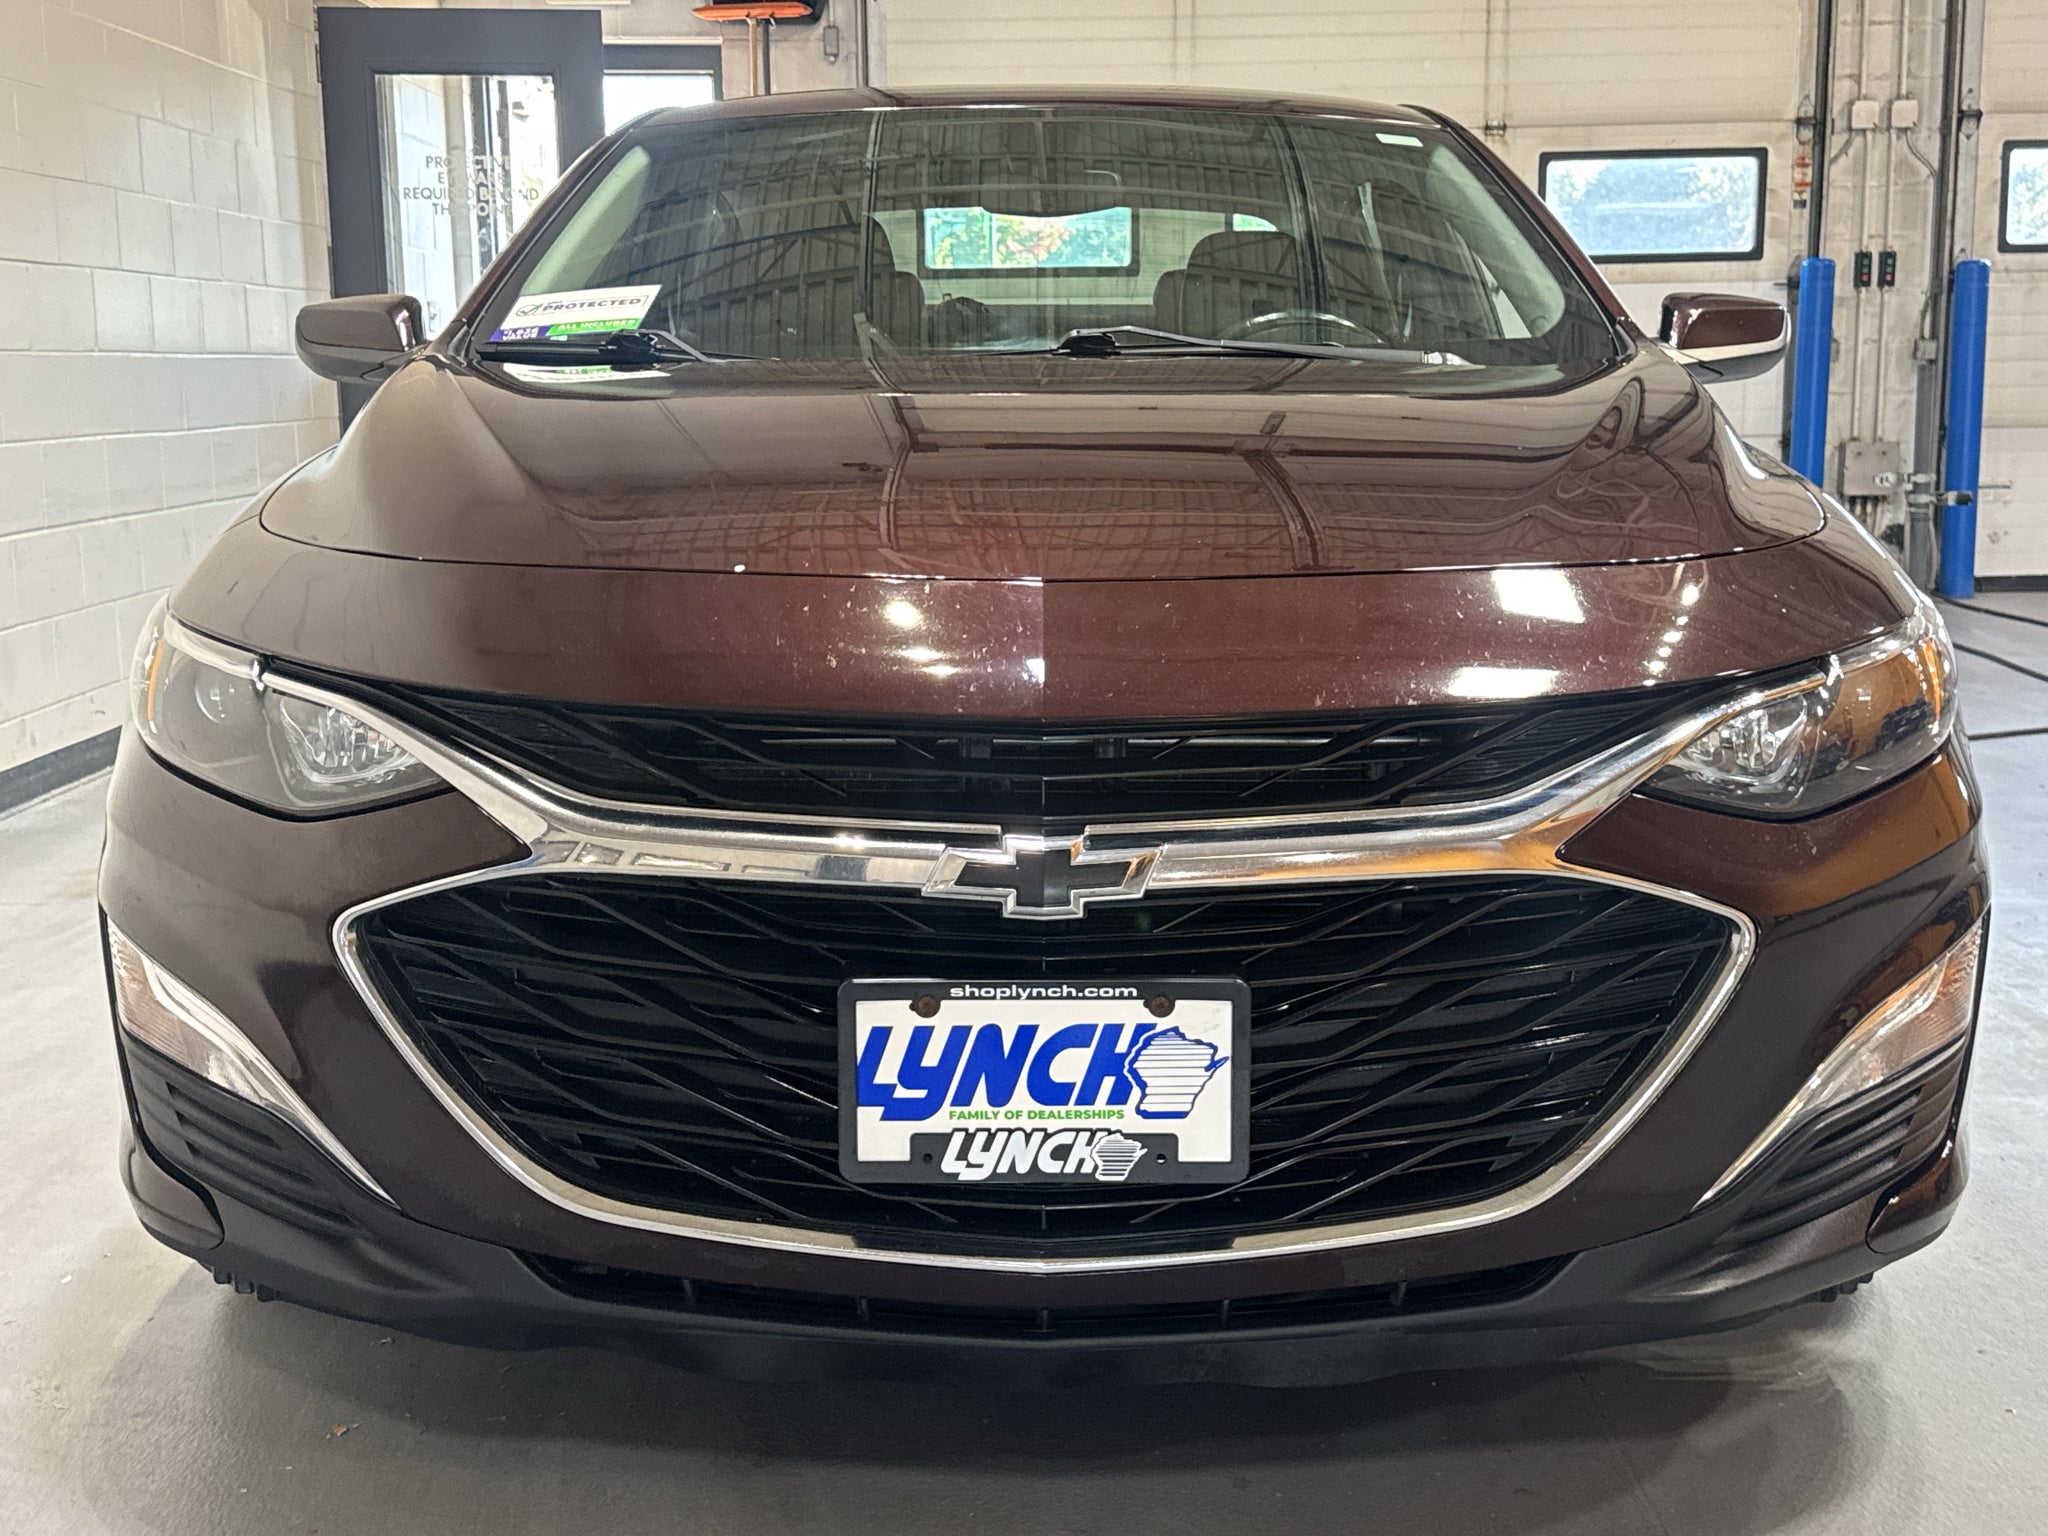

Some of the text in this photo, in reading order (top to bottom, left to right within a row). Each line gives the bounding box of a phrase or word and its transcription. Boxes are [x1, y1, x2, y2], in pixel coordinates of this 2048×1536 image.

[425, 155, 511, 169] PROECTIVE
[437, 171, 505, 185] EWARE
[403, 186, 476, 201] REQUID
[541, 298, 642, 312] PROTECTED
[950, 984, 1138, 1000] shoplynch.com
[856, 1023, 1157, 1121] LYNCH
[949, 1109, 1125, 1120] FAMILY OF DEALERSHIPS
[940, 1130, 1108, 1181] LYNCH
